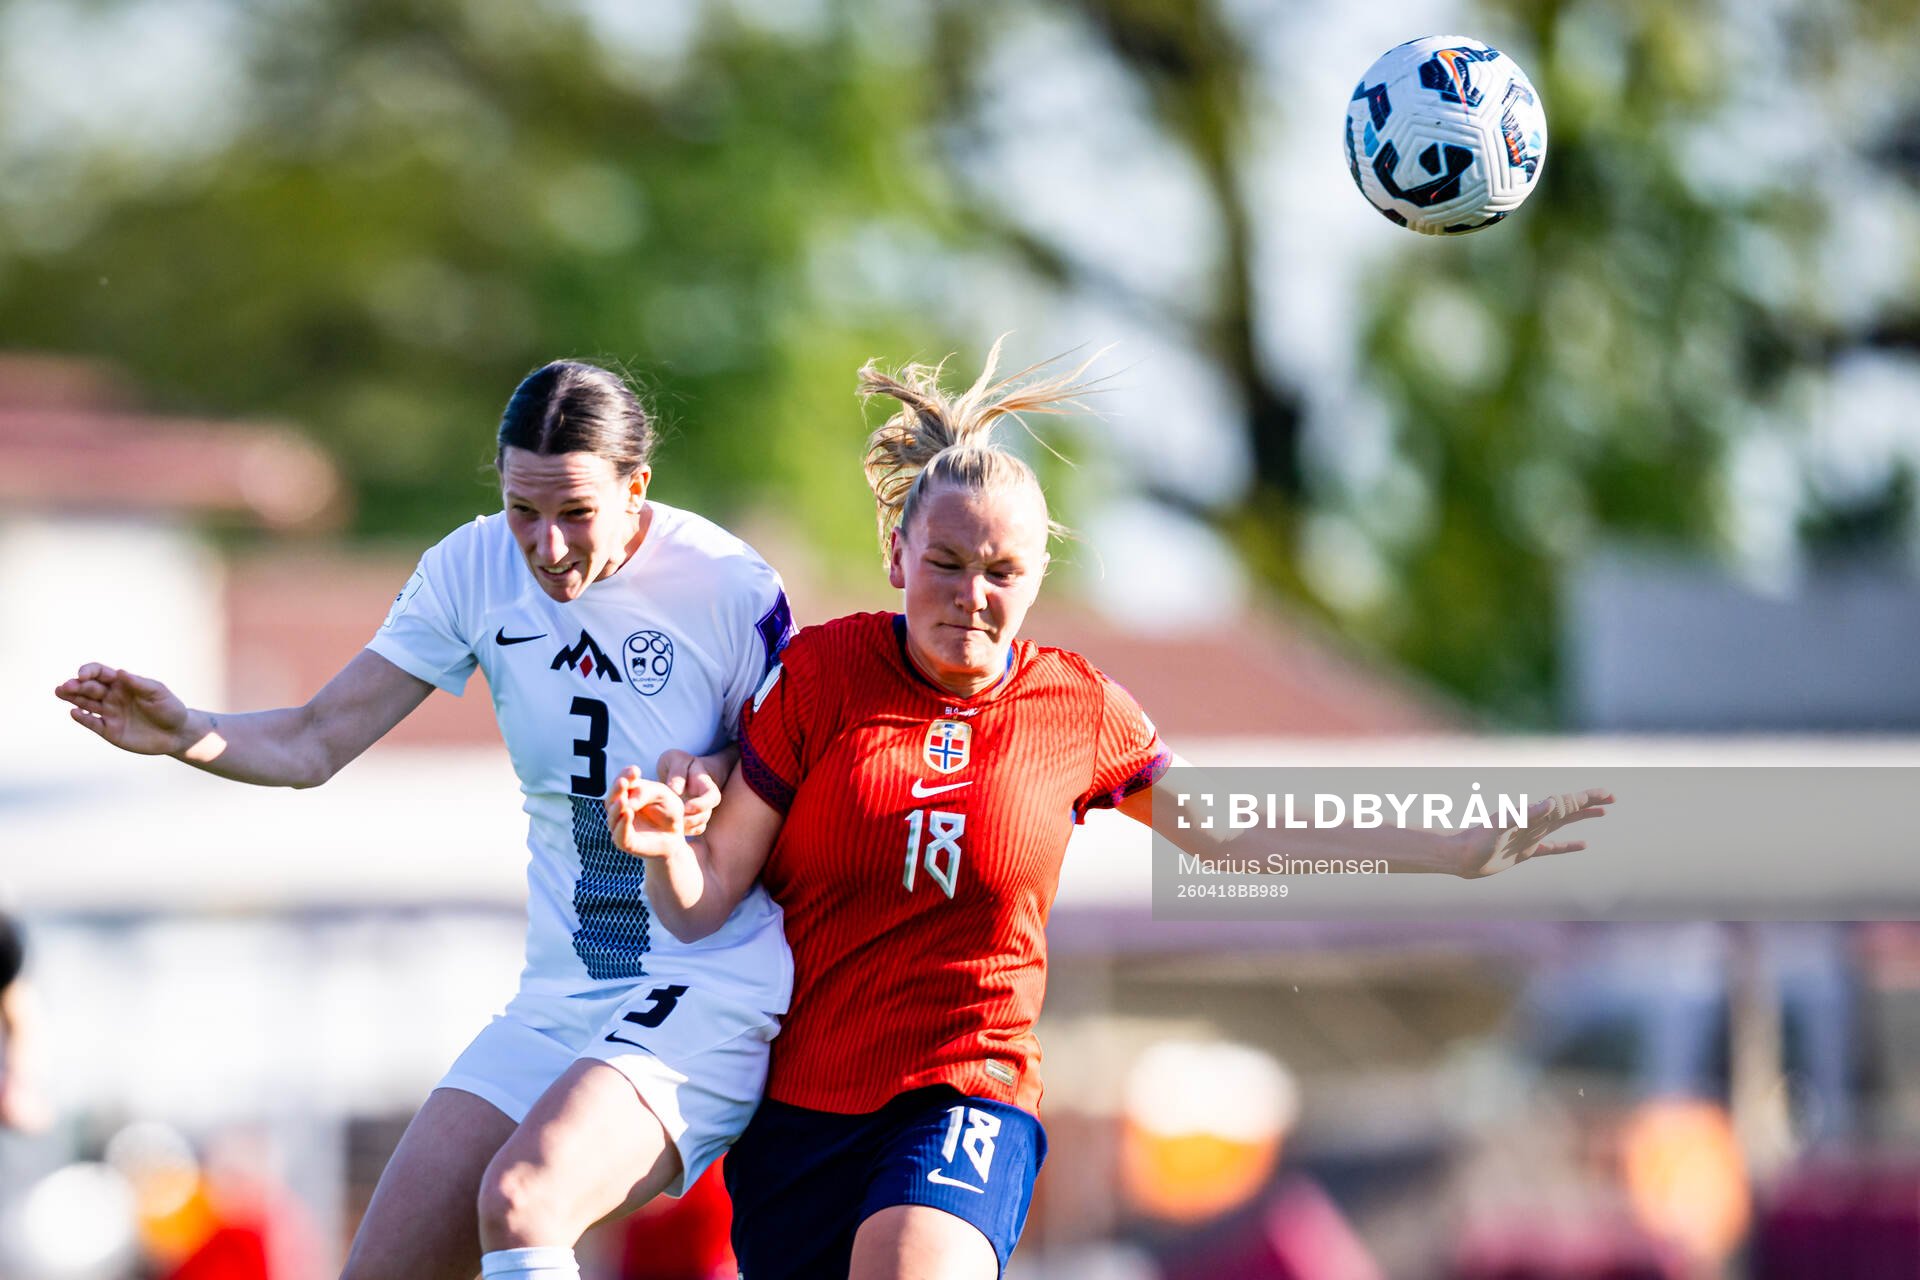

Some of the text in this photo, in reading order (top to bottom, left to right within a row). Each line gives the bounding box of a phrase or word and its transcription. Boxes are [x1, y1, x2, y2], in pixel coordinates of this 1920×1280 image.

[569, 696, 609, 797] 3
[902, 809, 966, 899] 18
[622, 984, 690, 1028] 3
[941, 1105, 1002, 1184] 18
